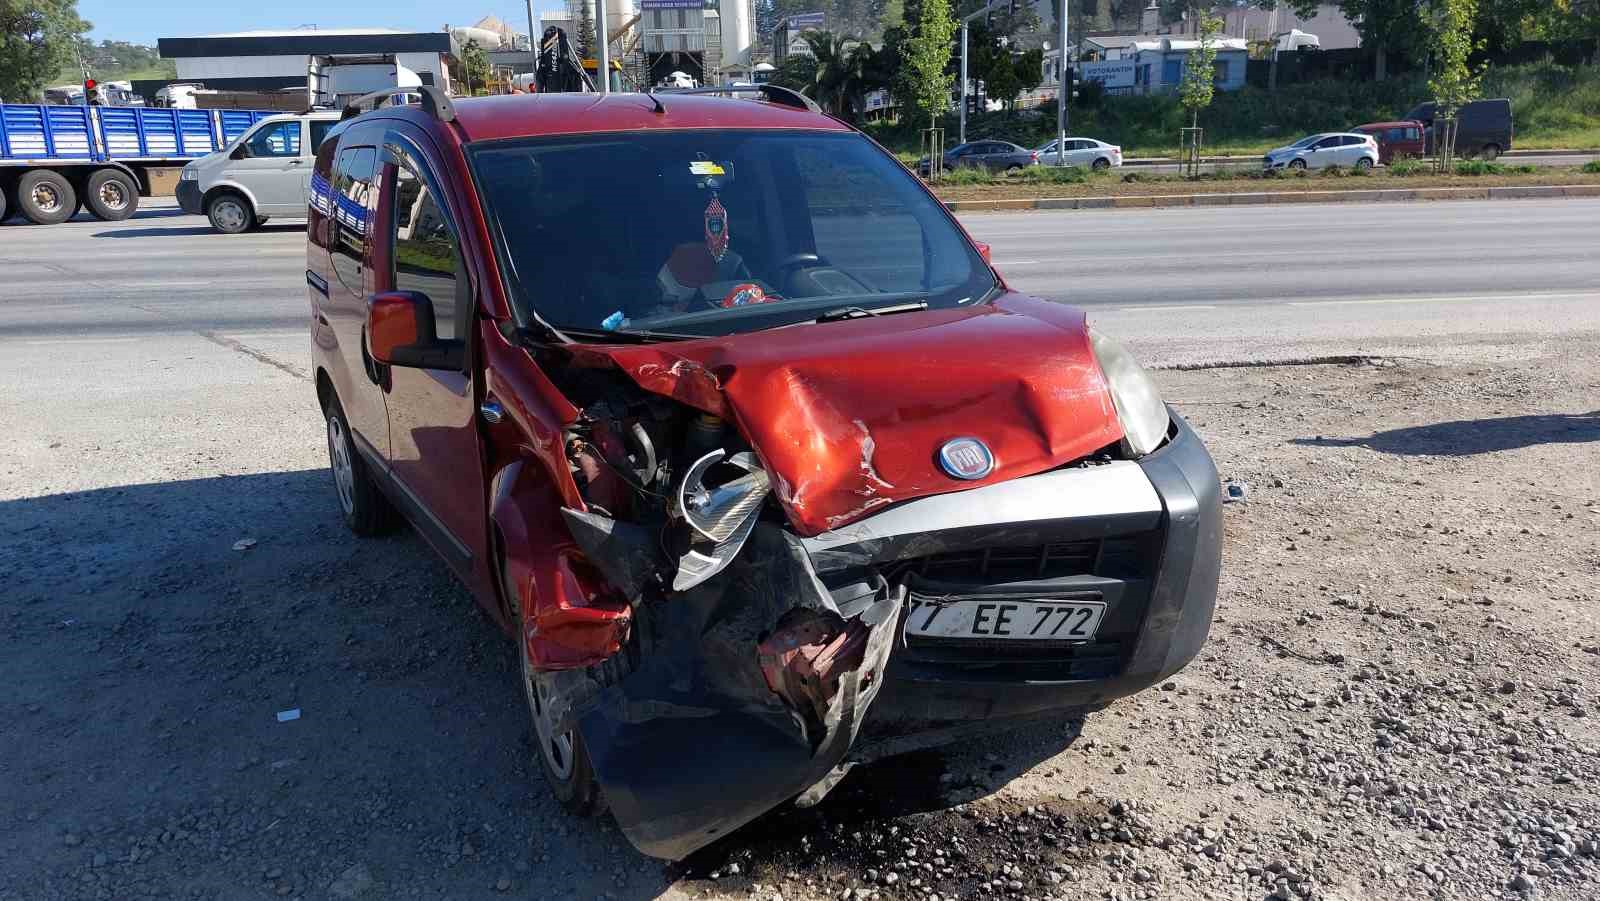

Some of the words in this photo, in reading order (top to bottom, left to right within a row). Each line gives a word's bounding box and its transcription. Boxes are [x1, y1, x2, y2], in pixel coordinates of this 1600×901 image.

[950, 447, 981, 468] FIAT
[972, 604, 1018, 635] EE
[1030, 607, 1093, 636] 772
